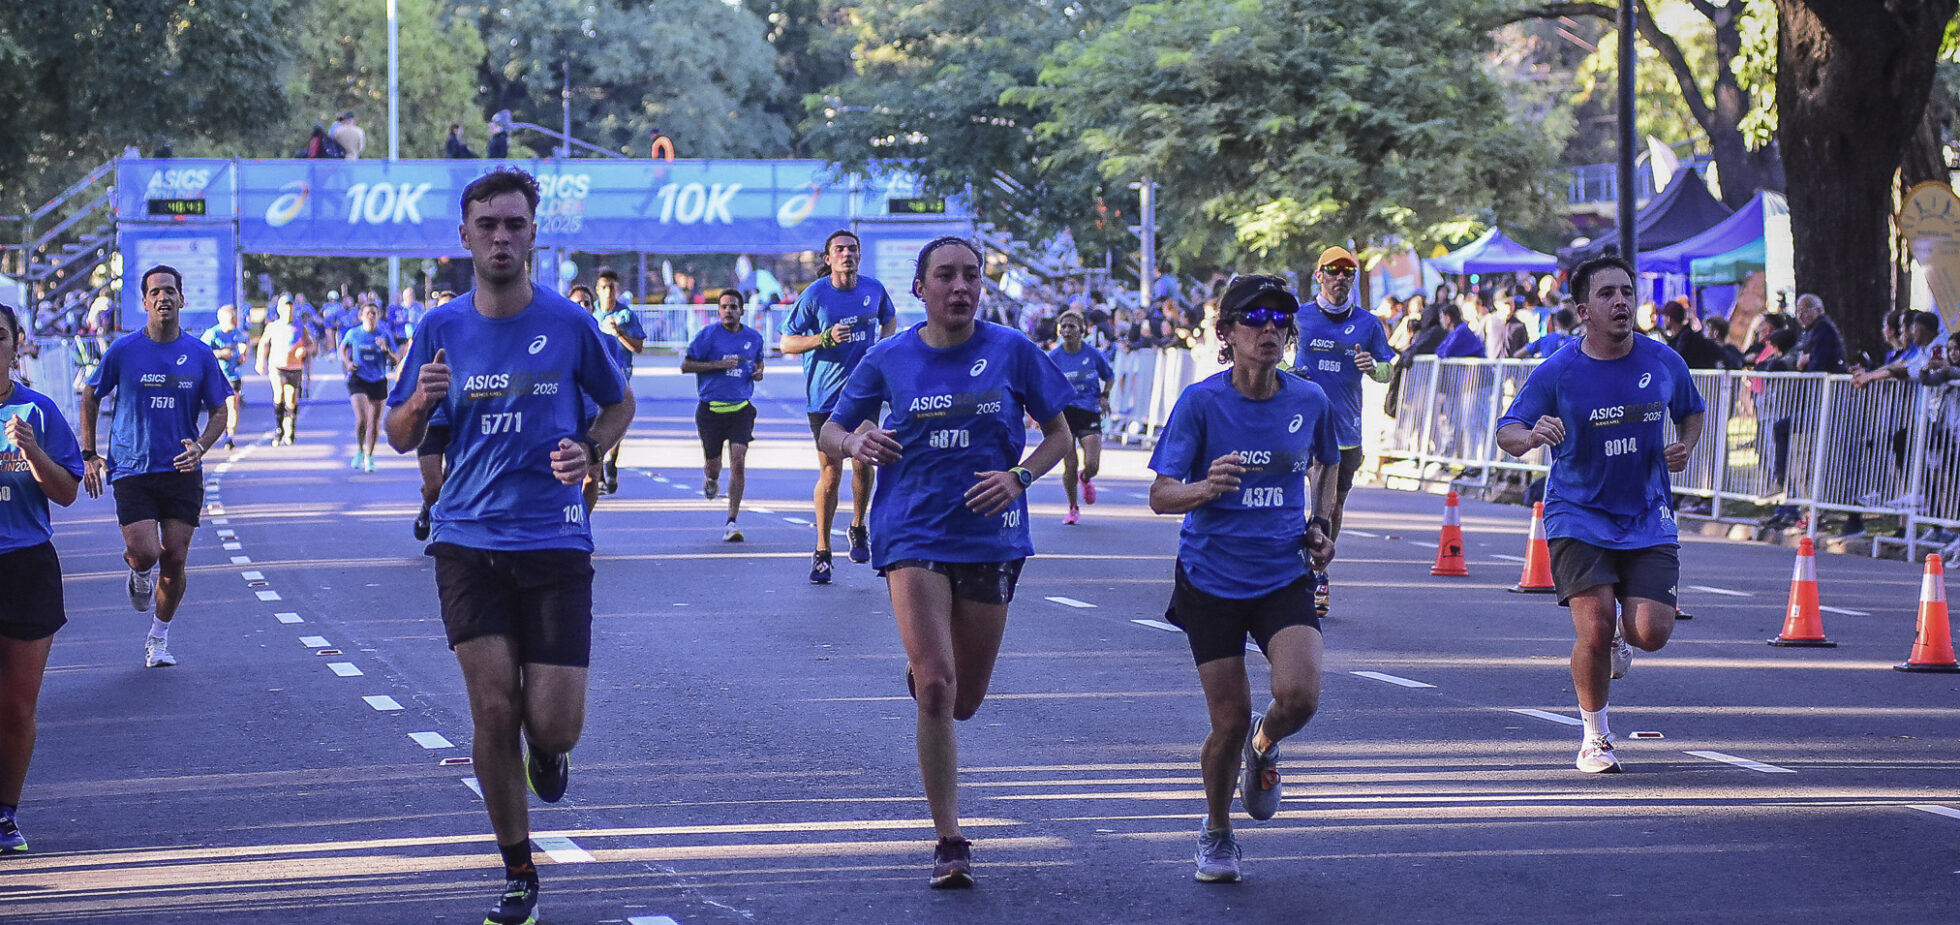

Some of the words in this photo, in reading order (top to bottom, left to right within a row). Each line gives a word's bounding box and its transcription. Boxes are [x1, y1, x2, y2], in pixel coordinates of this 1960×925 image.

[147, 169, 209, 190] ASICS
[536, 174, 591, 198] SICS
[346, 182, 431, 224] 10K
[657, 182, 743, 224] 10K
[1310, 338, 1335, 349] ASICS
[140, 373, 167, 383] ASICS
[463, 373, 510, 391] ASICS
[532, 383, 559, 395] 2025
[150, 396, 175, 409] 7578
[908, 394, 953, 412] ASICS
[976, 401, 1001, 415] 2025
[1589, 405, 1625, 421] ASICS
[1643, 411, 1662, 422] 2025
[481, 412, 522, 435] 5771
[929, 429, 970, 449] 5870
[1605, 438, 1637, 456] 8014
[1239, 450, 1272, 465] SICS
[1242, 486, 1284, 508] 4376
